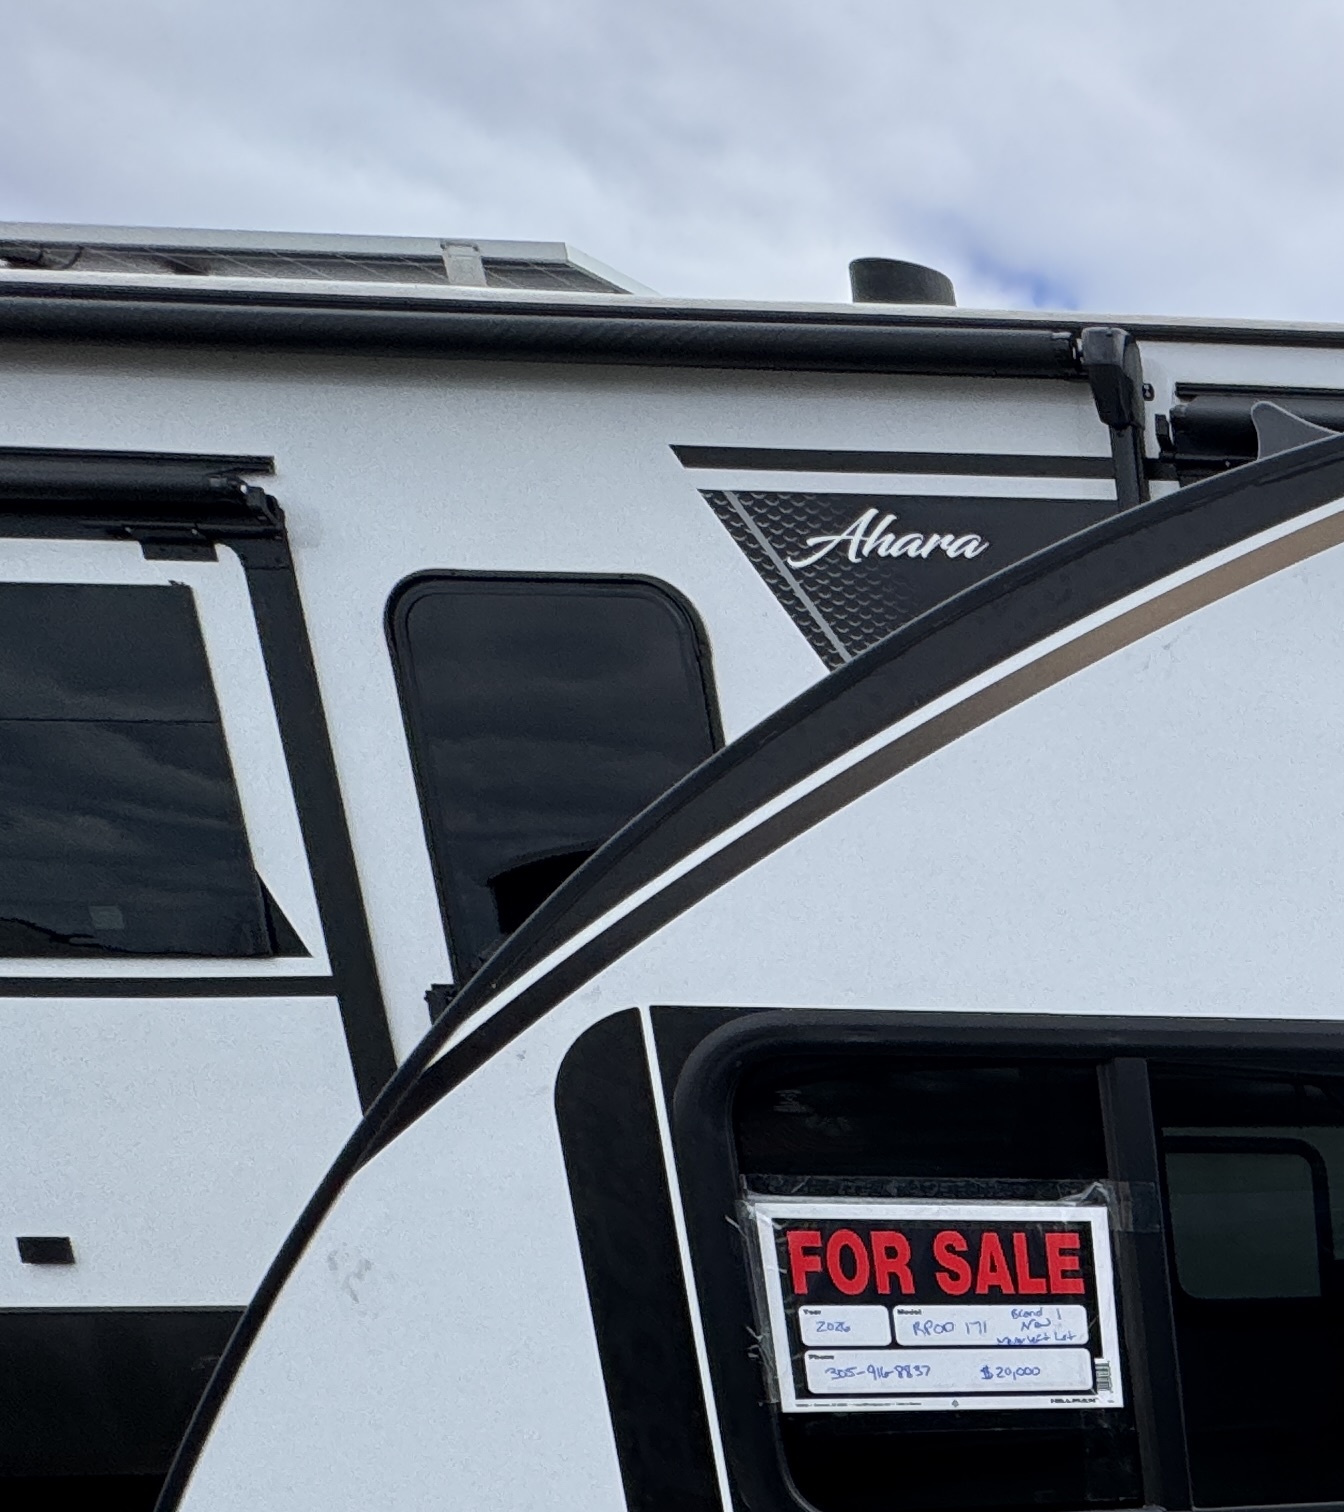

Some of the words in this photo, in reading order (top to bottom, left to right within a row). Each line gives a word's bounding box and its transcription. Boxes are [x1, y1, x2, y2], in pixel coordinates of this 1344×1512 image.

[786, 507, 990, 569] Ahara
[786, 1229, 915, 1296] FOR
[932, 1230, 1086, 1296] SALE
[815, 1320, 851, 1333] 2026
[965, 1321, 988, 1335] 171
